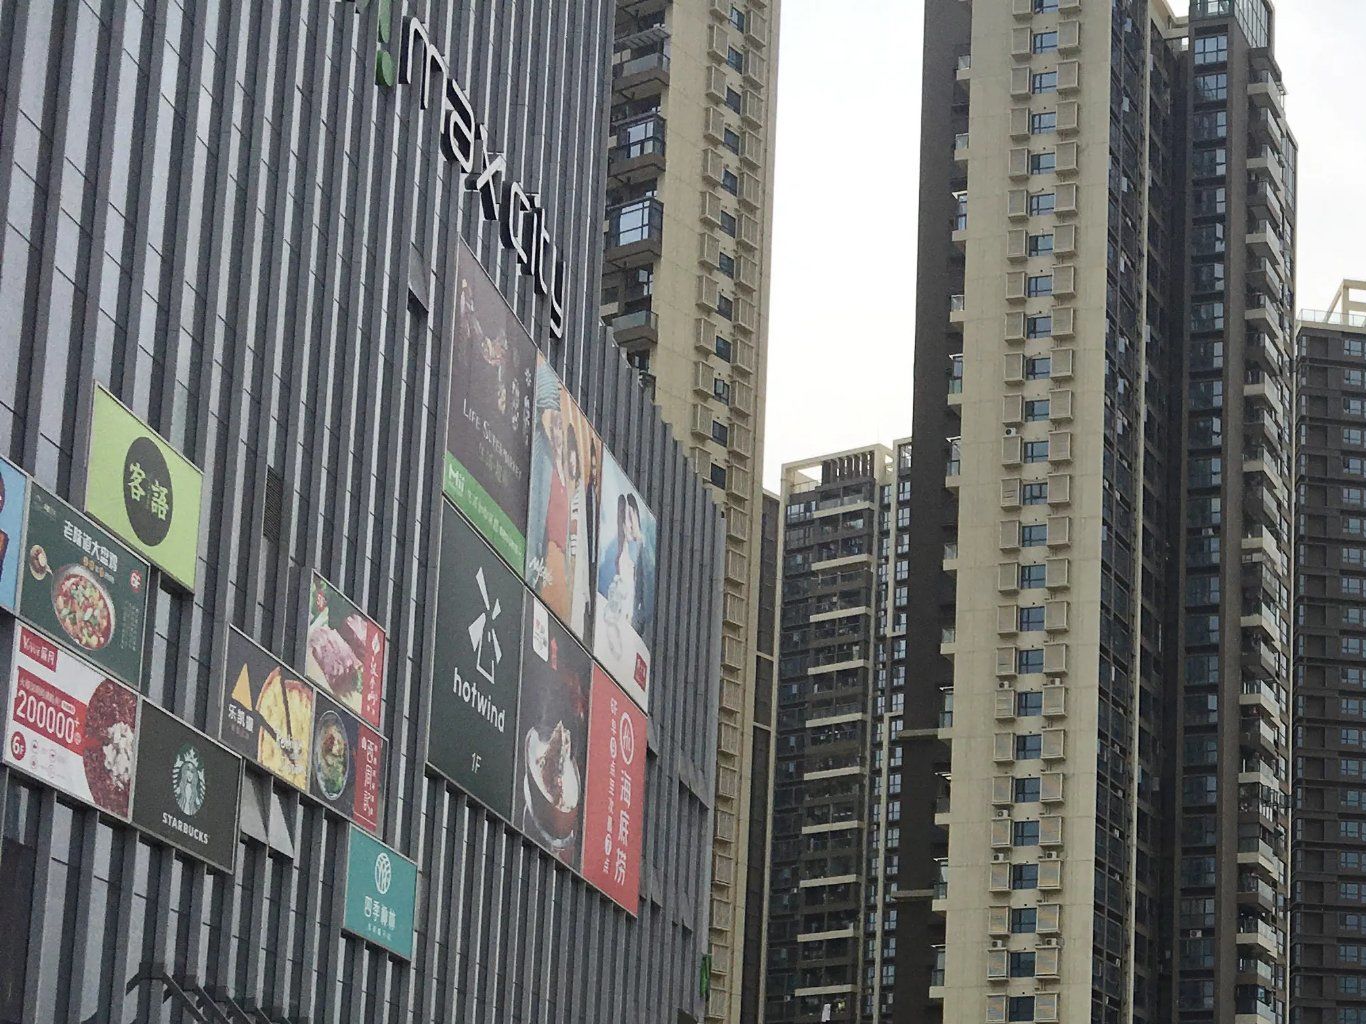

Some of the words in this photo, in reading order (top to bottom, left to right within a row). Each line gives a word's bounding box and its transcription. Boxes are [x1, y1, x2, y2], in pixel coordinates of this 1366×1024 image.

[453, 667, 506, 733] hotwind
[471, 752, 482, 774] 1F
[162, 812, 209, 844] STARBUCKS
